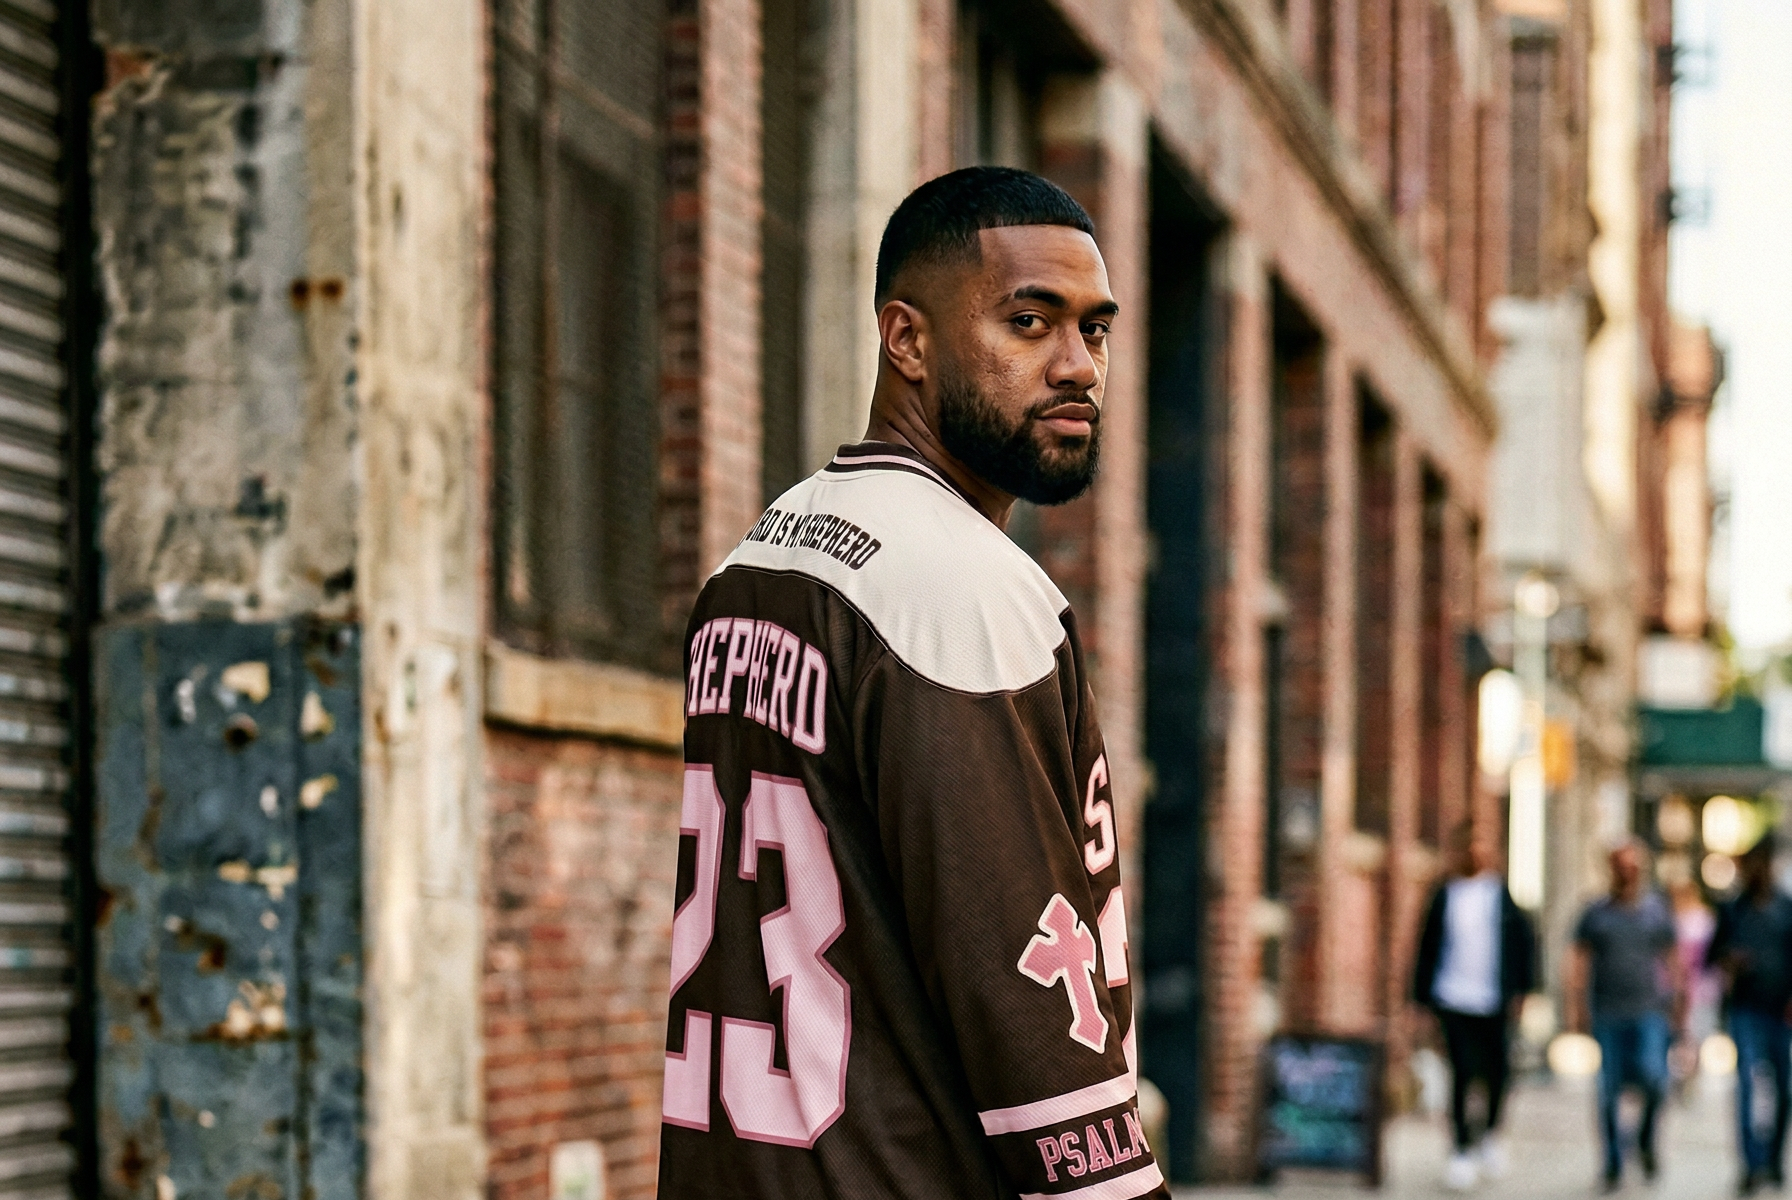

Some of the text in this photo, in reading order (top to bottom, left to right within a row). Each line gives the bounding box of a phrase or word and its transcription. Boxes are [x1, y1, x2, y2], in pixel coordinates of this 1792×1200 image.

[769, 511, 796, 546] IS
[784, 514, 813, 548] MY
[799, 513, 882, 570] SHEPHERD
[686, 616, 828, 755] HEPHERD
[661, 763, 851, 1150] 23
[1035, 1107, 1151, 1182] PSALM
